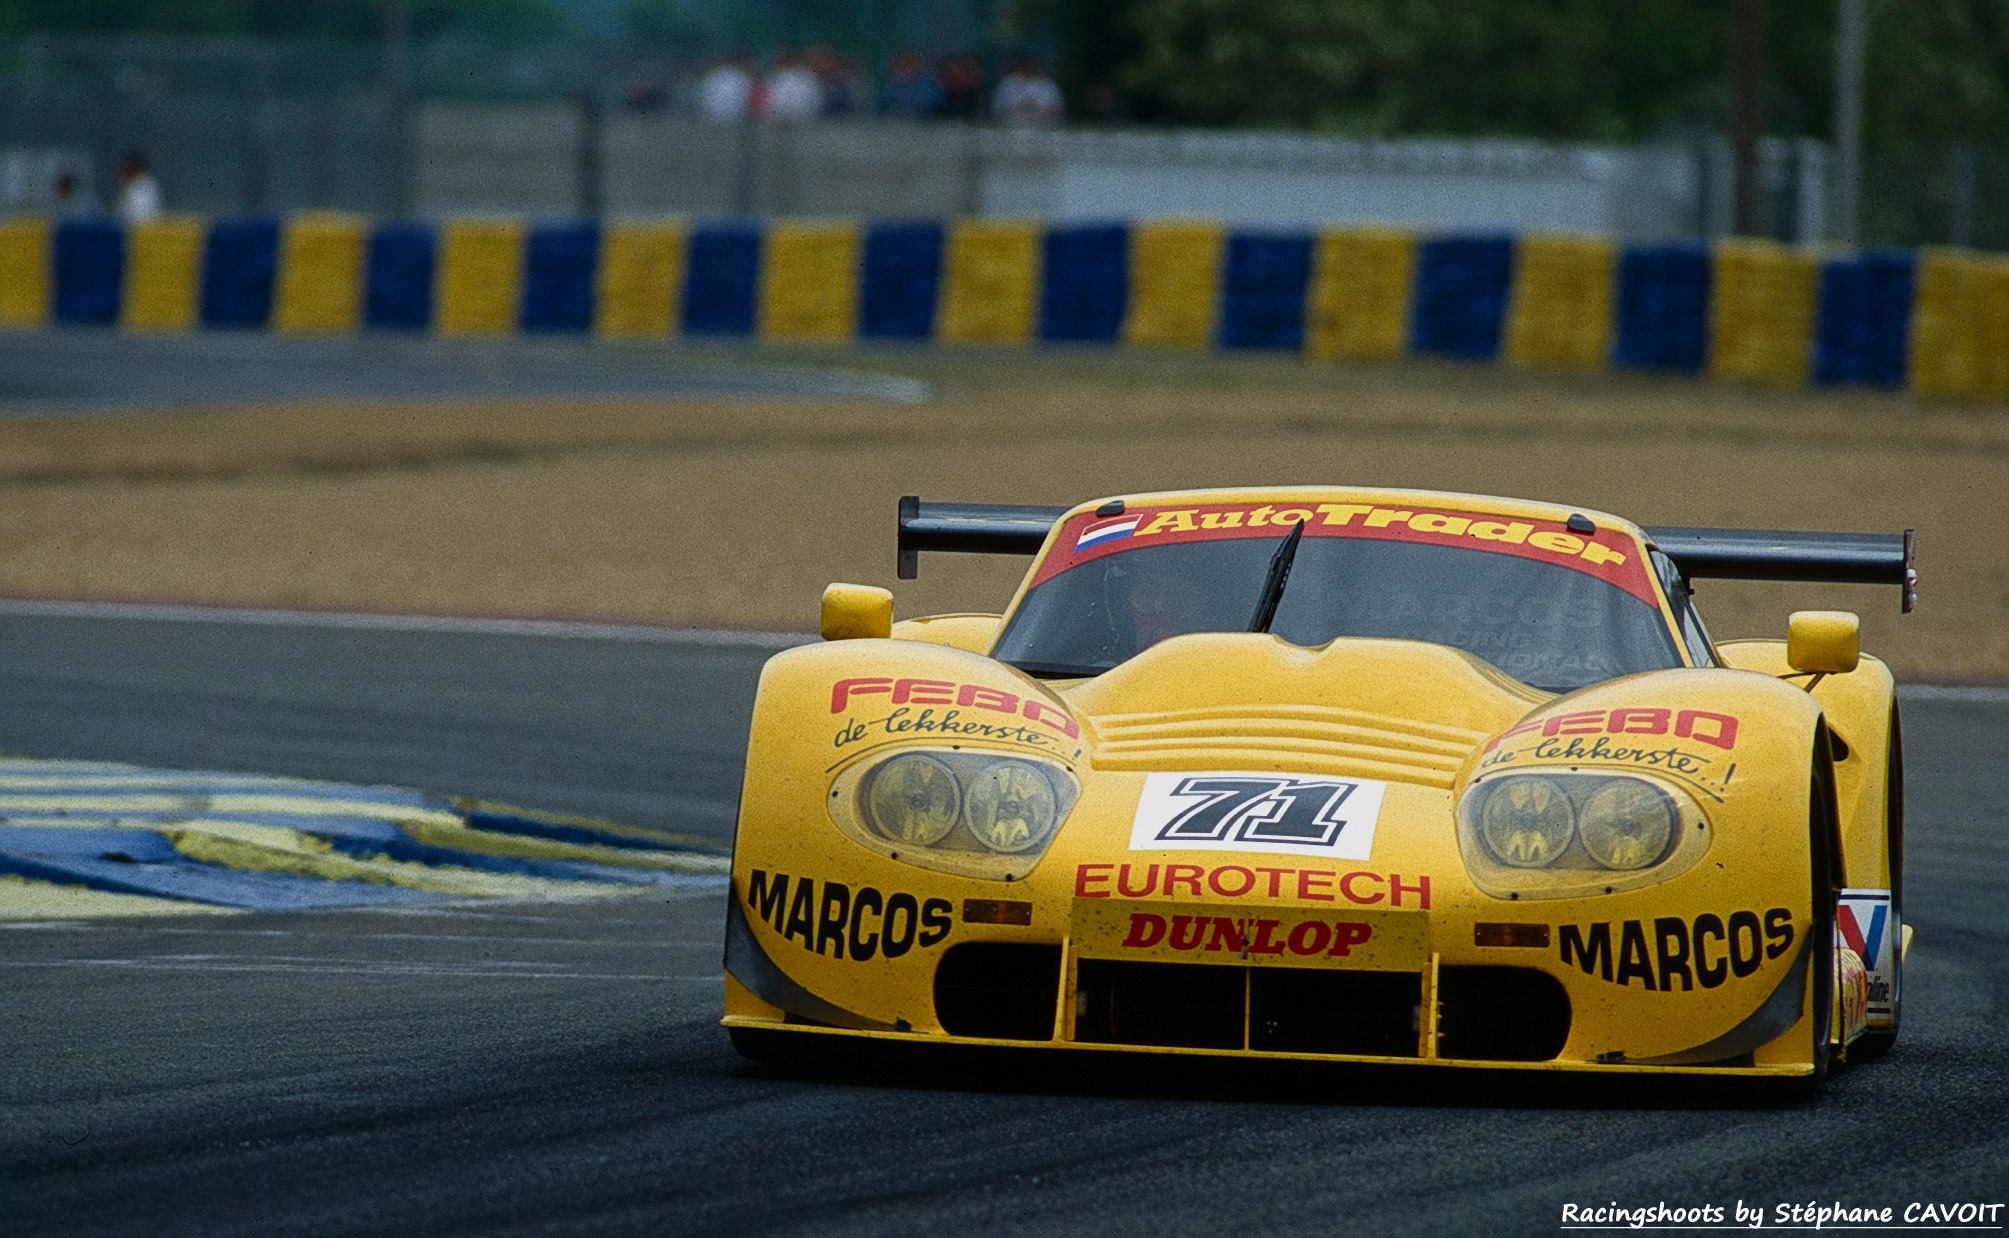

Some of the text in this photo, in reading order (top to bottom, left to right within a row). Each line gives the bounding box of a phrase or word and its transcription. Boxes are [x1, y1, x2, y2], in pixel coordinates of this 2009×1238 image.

[830, 677, 1080, 740] FEBO
[834, 718, 868, 748] de
[1153, 777, 1358, 848] 71
[748, 868, 953, 962] MARCOS
[1074, 863, 1431, 910] EUROTECH
[1121, 913, 1372, 957] DUNLOP
[1558, 907, 1795, 992] MARCOS
